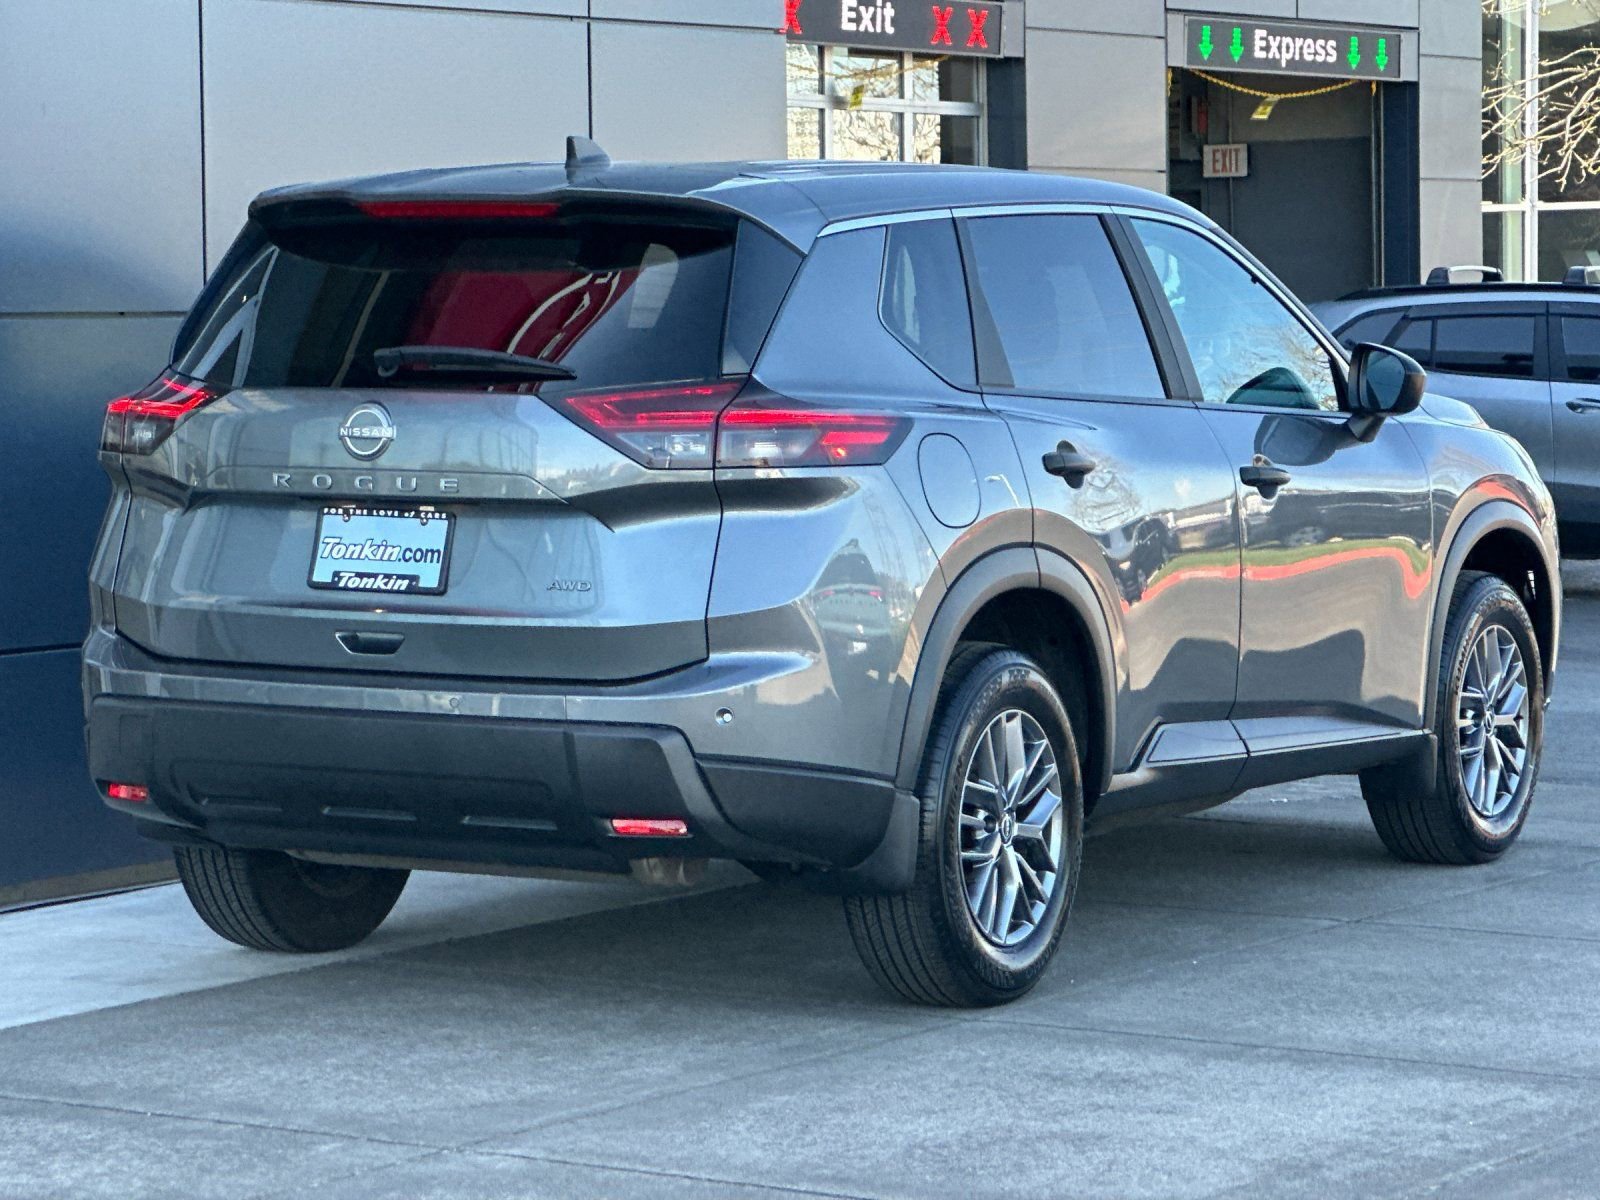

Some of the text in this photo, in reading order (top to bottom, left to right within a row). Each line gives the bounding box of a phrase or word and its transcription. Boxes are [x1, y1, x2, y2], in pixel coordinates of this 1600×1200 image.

[841, 0, 895, 34] Exit
[1254, 29, 1337, 67] Express
[1211, 148, 1241, 174] EXIT
[340, 426, 392, 438] NISSAN
[272, 472, 460, 494] ROGUE
[323, 507, 343, 515] FOR
[349, 508, 368, 516] THE
[373, 509, 399, 517] LOVE
[320, 536, 442, 564] Tonkin.com
[338, 572, 409, 591] Tonkin
[546, 579, 592, 592] AWD
